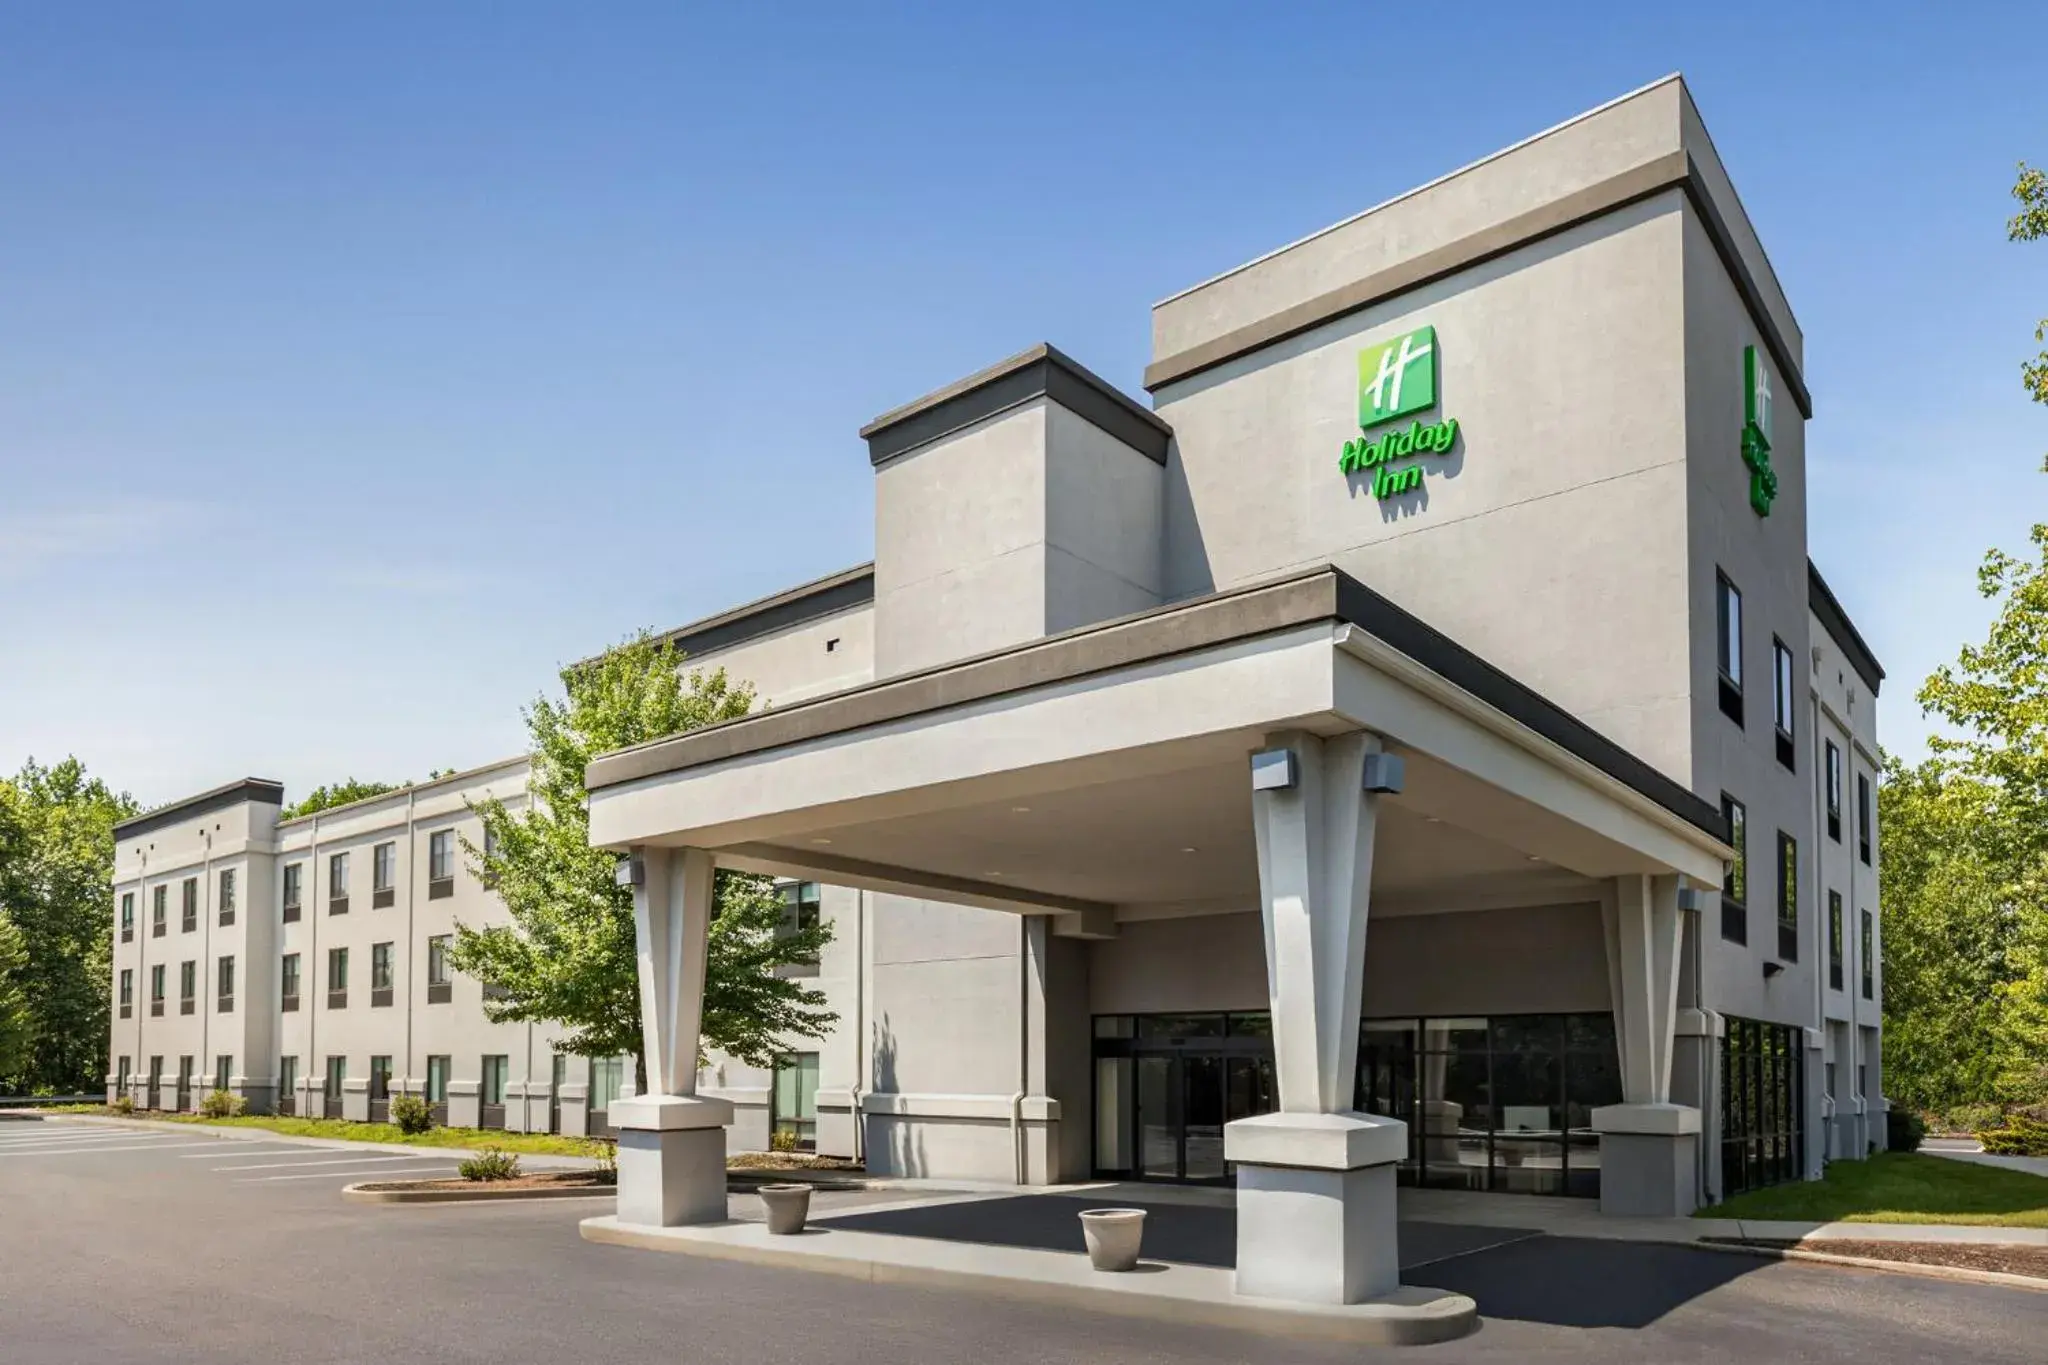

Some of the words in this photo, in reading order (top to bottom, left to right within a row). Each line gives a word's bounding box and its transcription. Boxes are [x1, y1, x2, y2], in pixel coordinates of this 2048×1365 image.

[1365, 336, 1432, 412] H
[1339, 418, 1459, 475] Holiday
[1372, 465, 1422, 501] Inn
